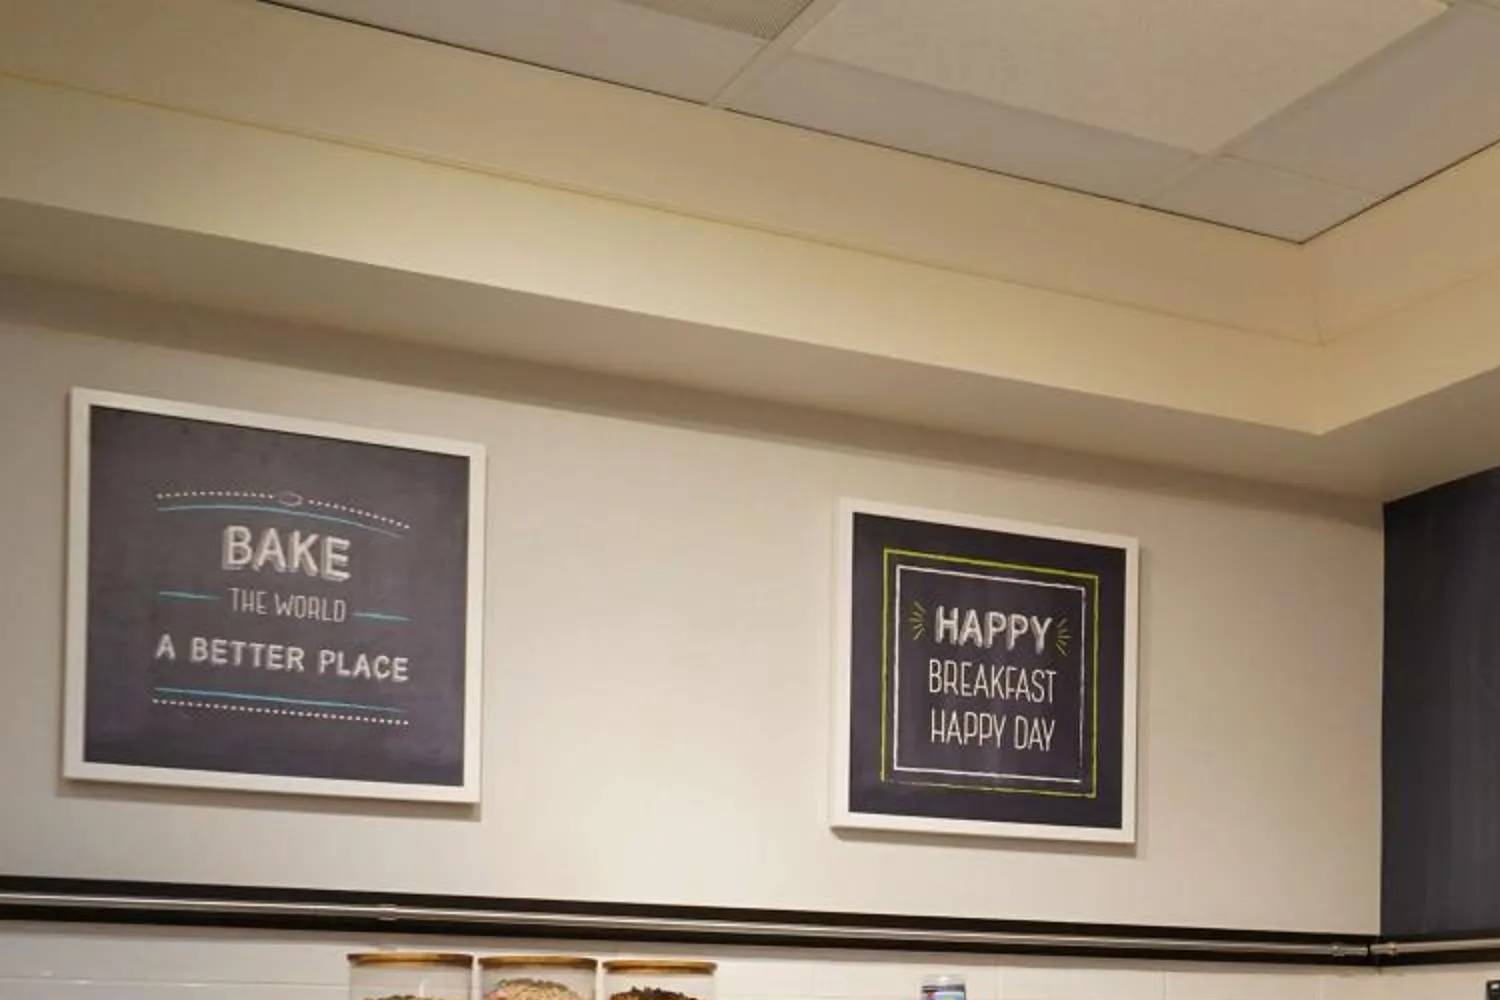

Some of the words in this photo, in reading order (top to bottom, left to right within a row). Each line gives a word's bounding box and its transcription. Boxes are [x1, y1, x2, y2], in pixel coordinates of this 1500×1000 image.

[222, 524, 351, 581] BAKE
[228, 587, 267, 616] THE
[274, 593, 346, 622] WORLD
[934, 605, 1053, 654] HAPPY
[154, 633, 176, 660] A
[189, 637, 305, 672] BETTER
[318, 648, 410, 682] PLACE
[929, 658, 1057, 704] BREAKFAST
[931, 709, 1007, 749] HAPPY
[1014, 715, 1056, 752] DAY
